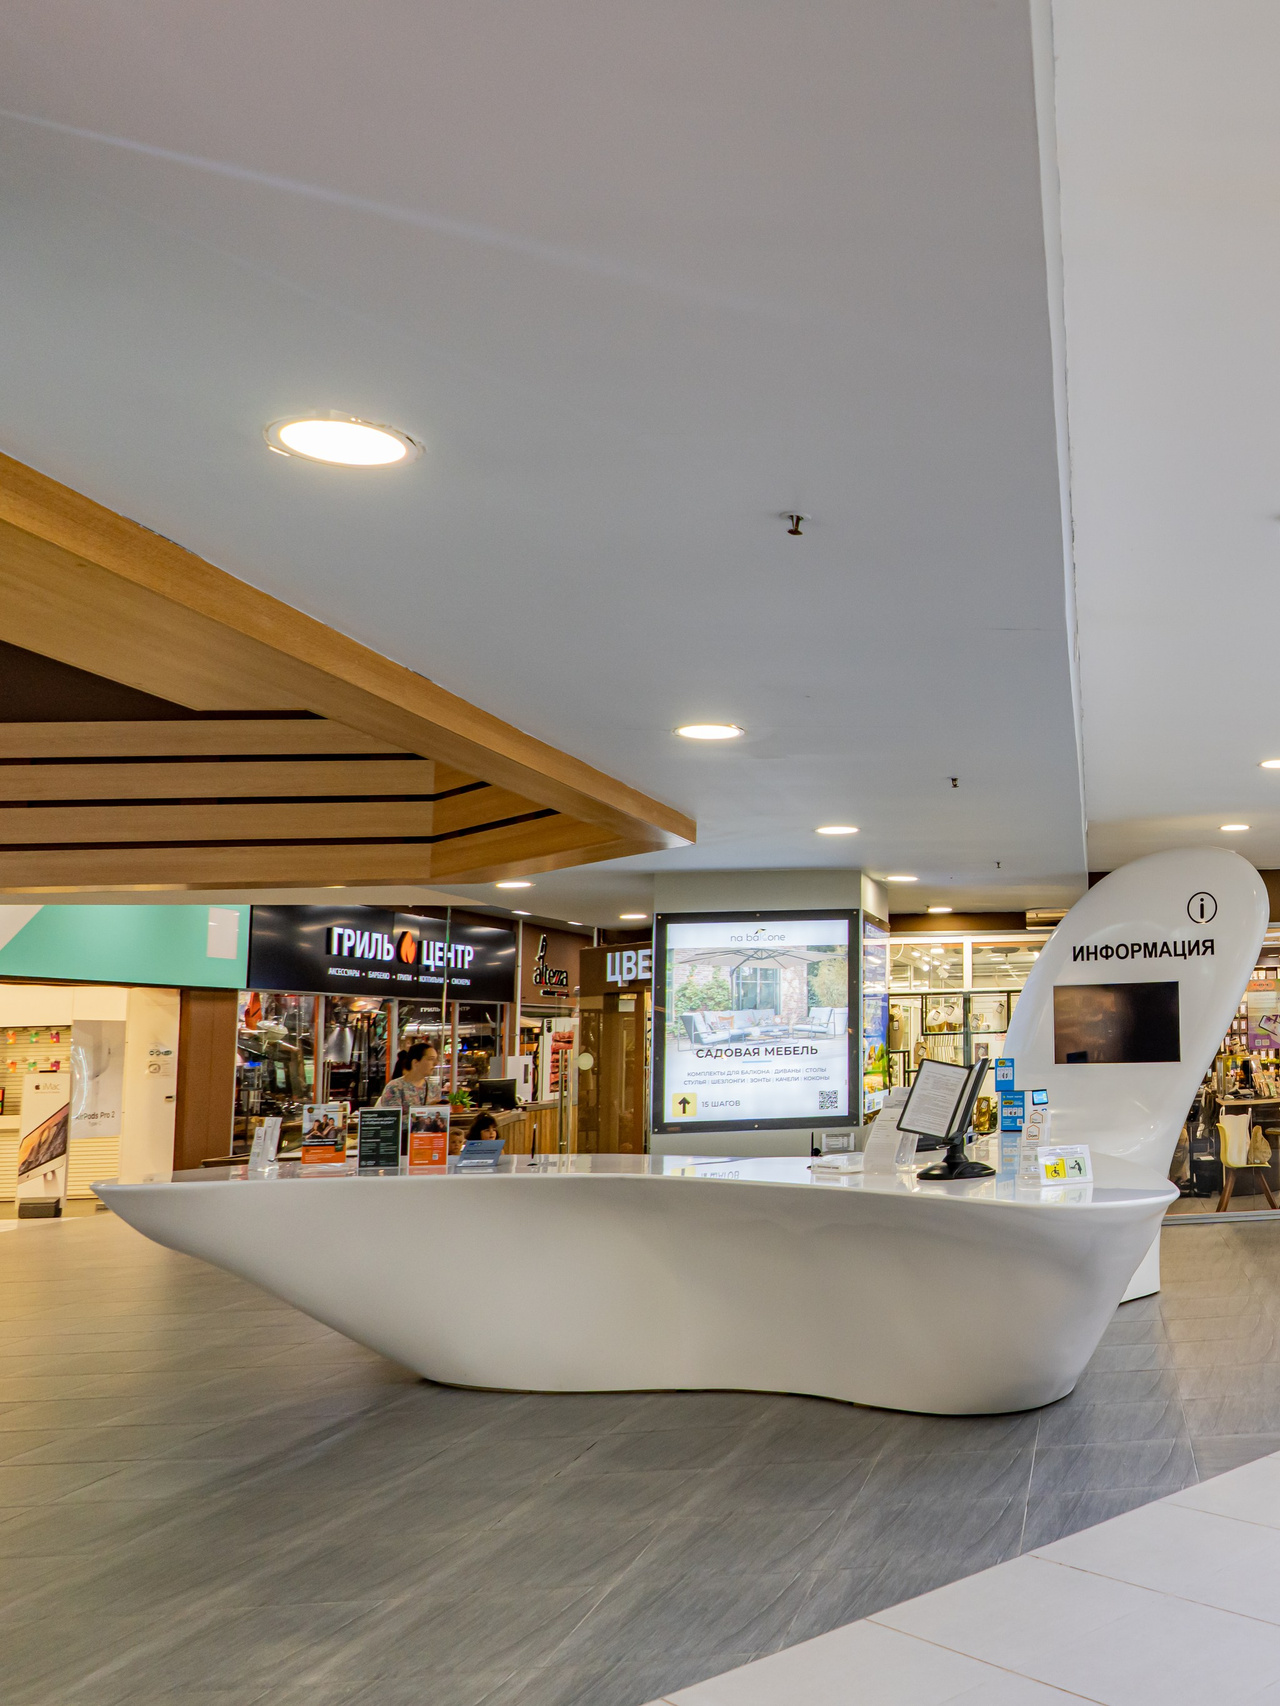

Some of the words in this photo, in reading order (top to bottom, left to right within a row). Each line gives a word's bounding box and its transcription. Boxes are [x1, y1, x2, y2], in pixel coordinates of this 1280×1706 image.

[331, 926, 395, 961] ГРИЛЬ
[421, 939, 475, 971] ЦЕНТР
[1072, 938, 1215, 962] ИНФОРМАЦИЯ
[696, 1048, 761, 1059] САДОВАЯ
[764, 1046, 819, 1056] МЕБЕЛЬ
[711, 1100, 741, 1108] ШАГОВ
[100, 1111, 111, 1119] Pro
